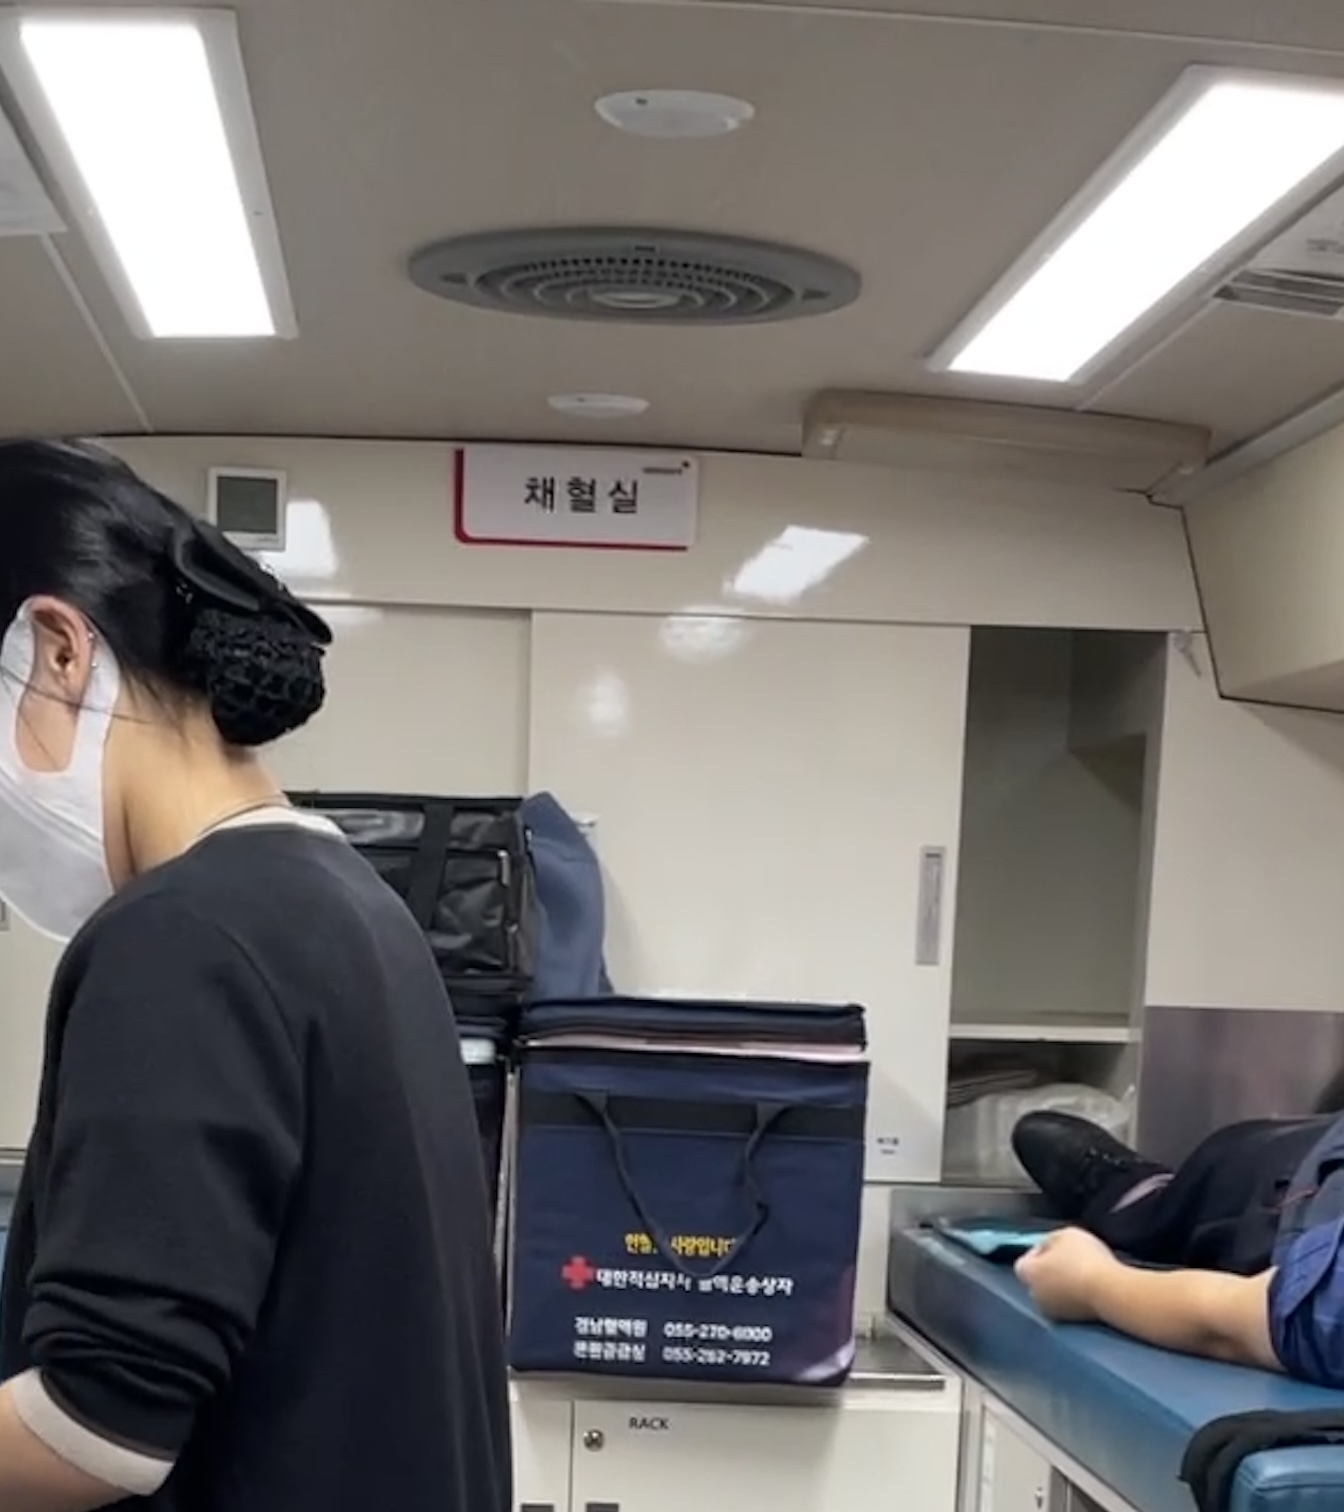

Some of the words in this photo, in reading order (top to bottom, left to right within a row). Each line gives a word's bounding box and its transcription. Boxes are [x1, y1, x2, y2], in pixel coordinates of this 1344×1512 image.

[523, 476, 639, 514] 채혈실
[596, 1267, 692, 1291] 대한적십자사
[628, 1416, 670, 1431] RACK
